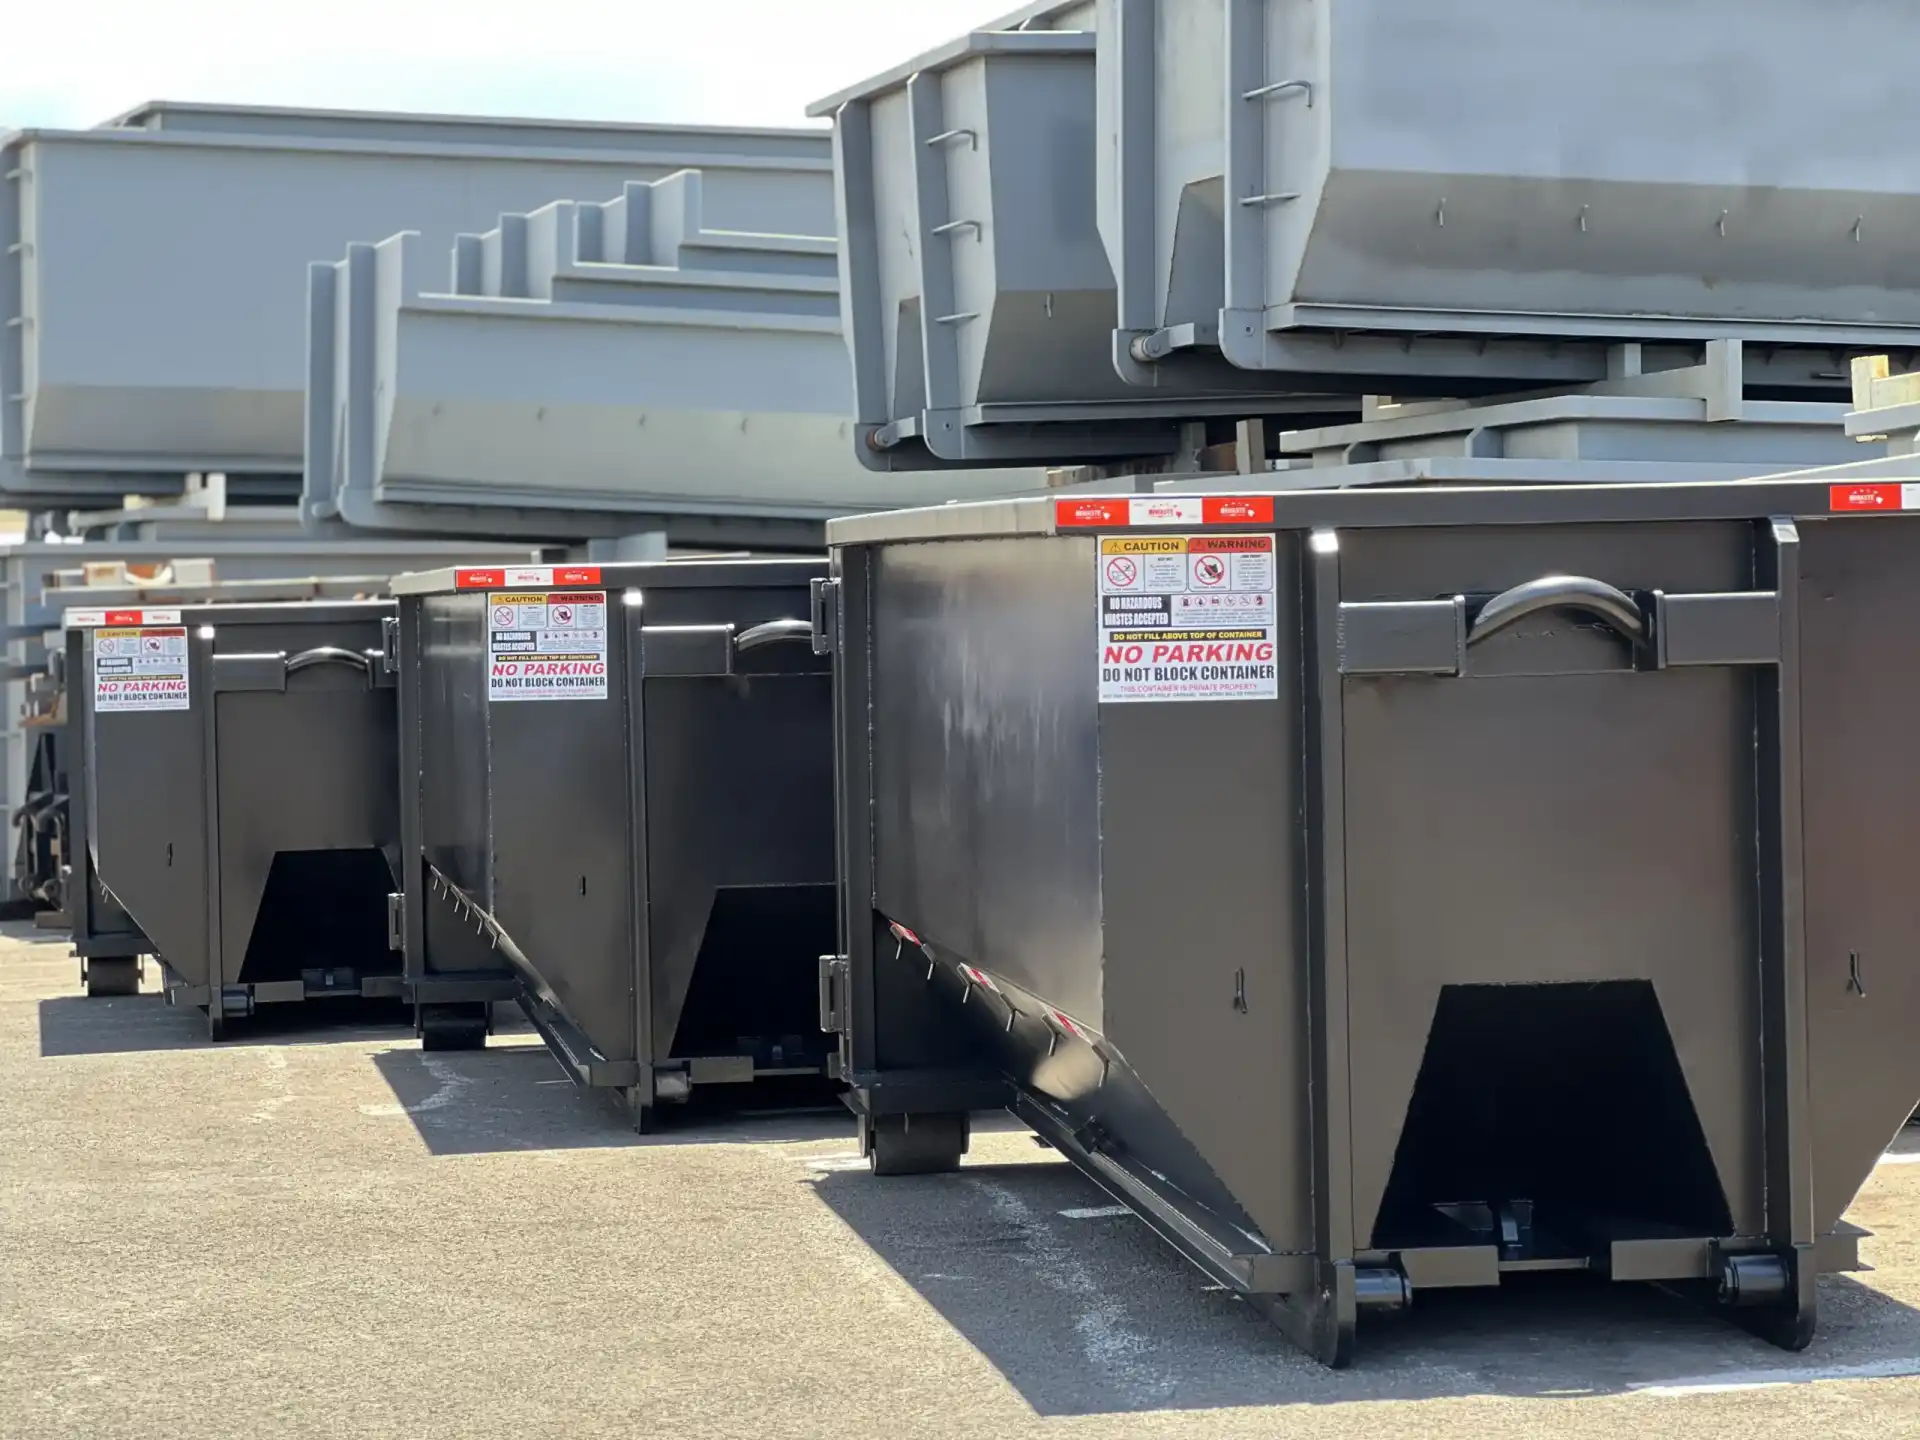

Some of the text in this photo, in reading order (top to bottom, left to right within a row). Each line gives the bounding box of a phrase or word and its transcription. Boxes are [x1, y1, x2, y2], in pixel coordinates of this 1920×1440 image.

[1124, 542, 1179, 551] CAUTION
[1208, 540, 1266, 548] WARNING
[1110, 597, 1120, 609] NO
[1105, 613, 1132, 625] WASTES
[1134, 613, 1168, 625] ACCEPTED
[1104, 643, 1273, 664] NO PARKING
[492, 663, 604, 676] NO PARKING
[1103, 665, 1274, 682] DO NOT BLOCK CONTAINER
[98, 682, 187, 692] NO PARKING
[492, 677, 605, 687] DO NOT BLOCK CONTAINER
[1219, 683, 1257, 691] PROPERTY
[149, 692, 187, 700] CONTAINER
